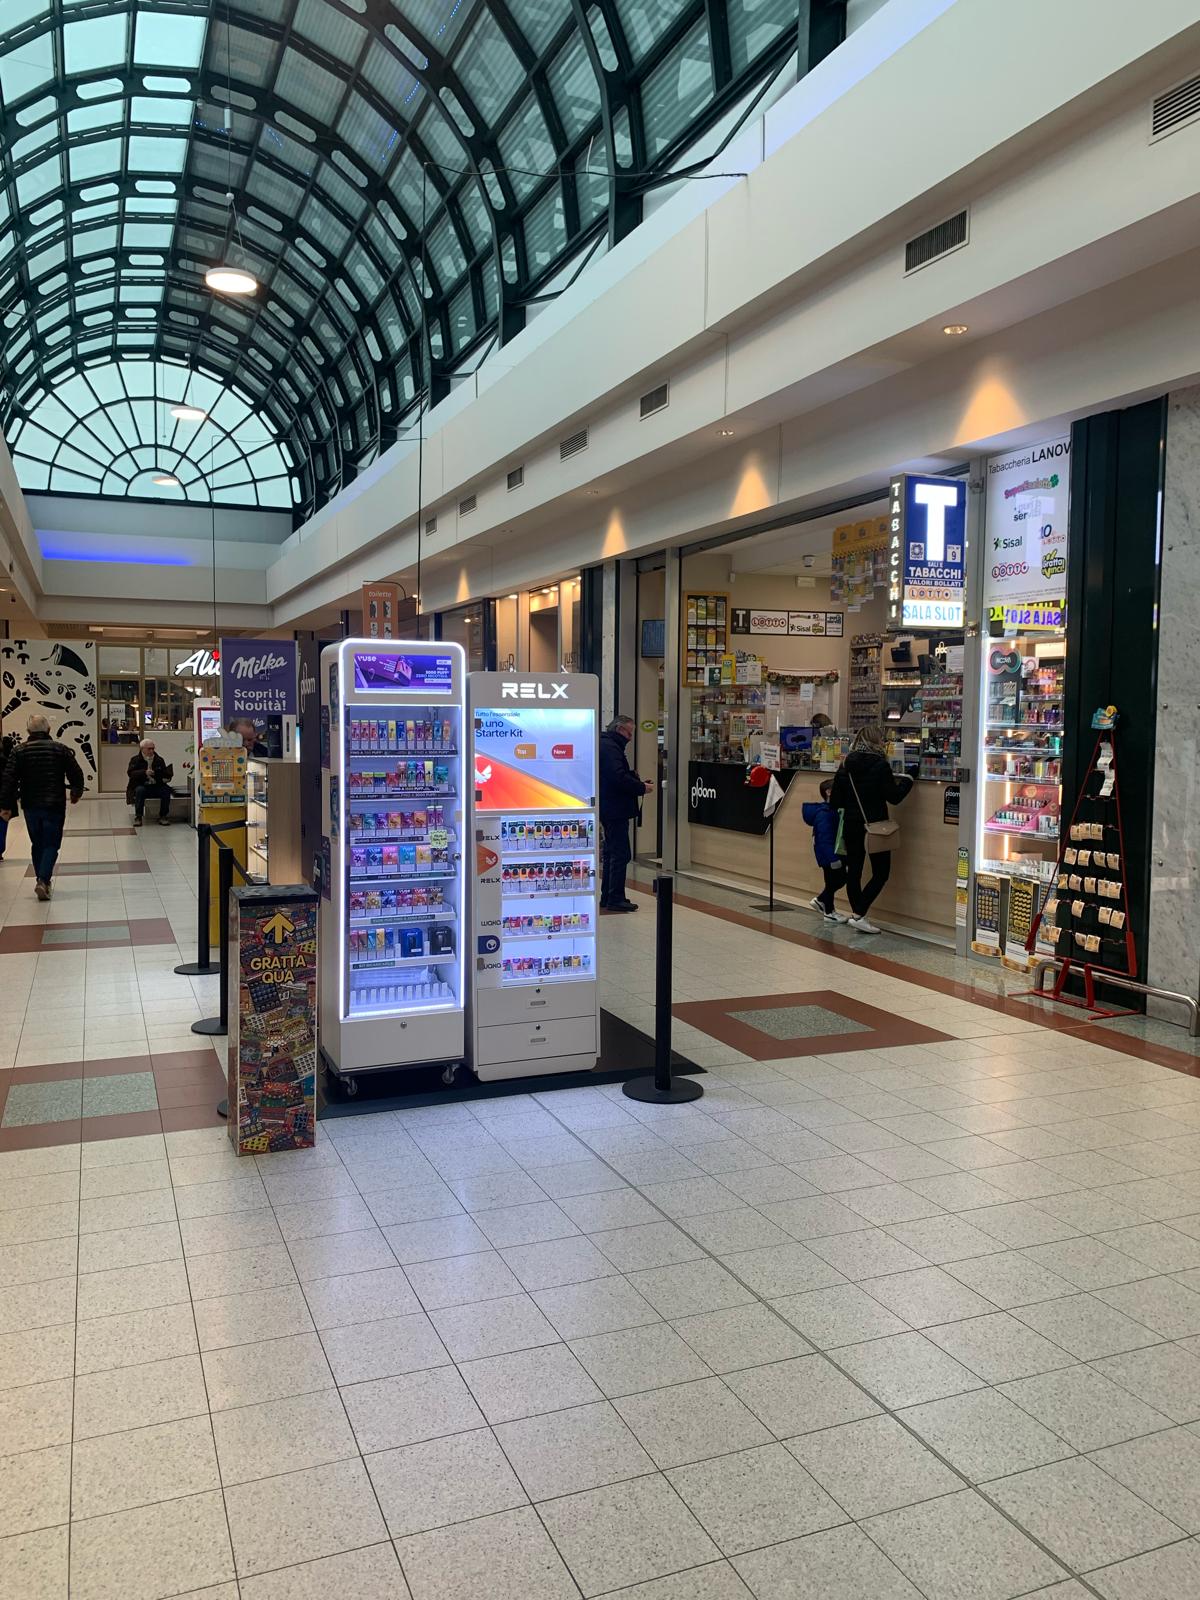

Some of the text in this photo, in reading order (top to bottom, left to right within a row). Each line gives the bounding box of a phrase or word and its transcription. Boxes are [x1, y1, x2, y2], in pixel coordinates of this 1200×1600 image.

[988, 457, 1030, 474] Tabaccheria
[915, 483, 958, 561] T
[890, 482, 900, 618] TABACCHI
[1002, 536, 1022, 549] Sisal
[952, 550, 956, 560] 9
[908, 566, 962, 579] TABACCHI
[736, 610, 746, 626] T
[903, 604, 961, 620] SALA SLOT
[230, 652, 288, 679] Milka
[234, 689, 286, 700] Scopri le
[502, 682, 568, 698] RELX
[475, 729, 523, 737] Starter Kit
[691, 776, 716, 808] ploom
[250, 954, 306, 970] GRATTA
[262, 970, 294, 984] QUA
